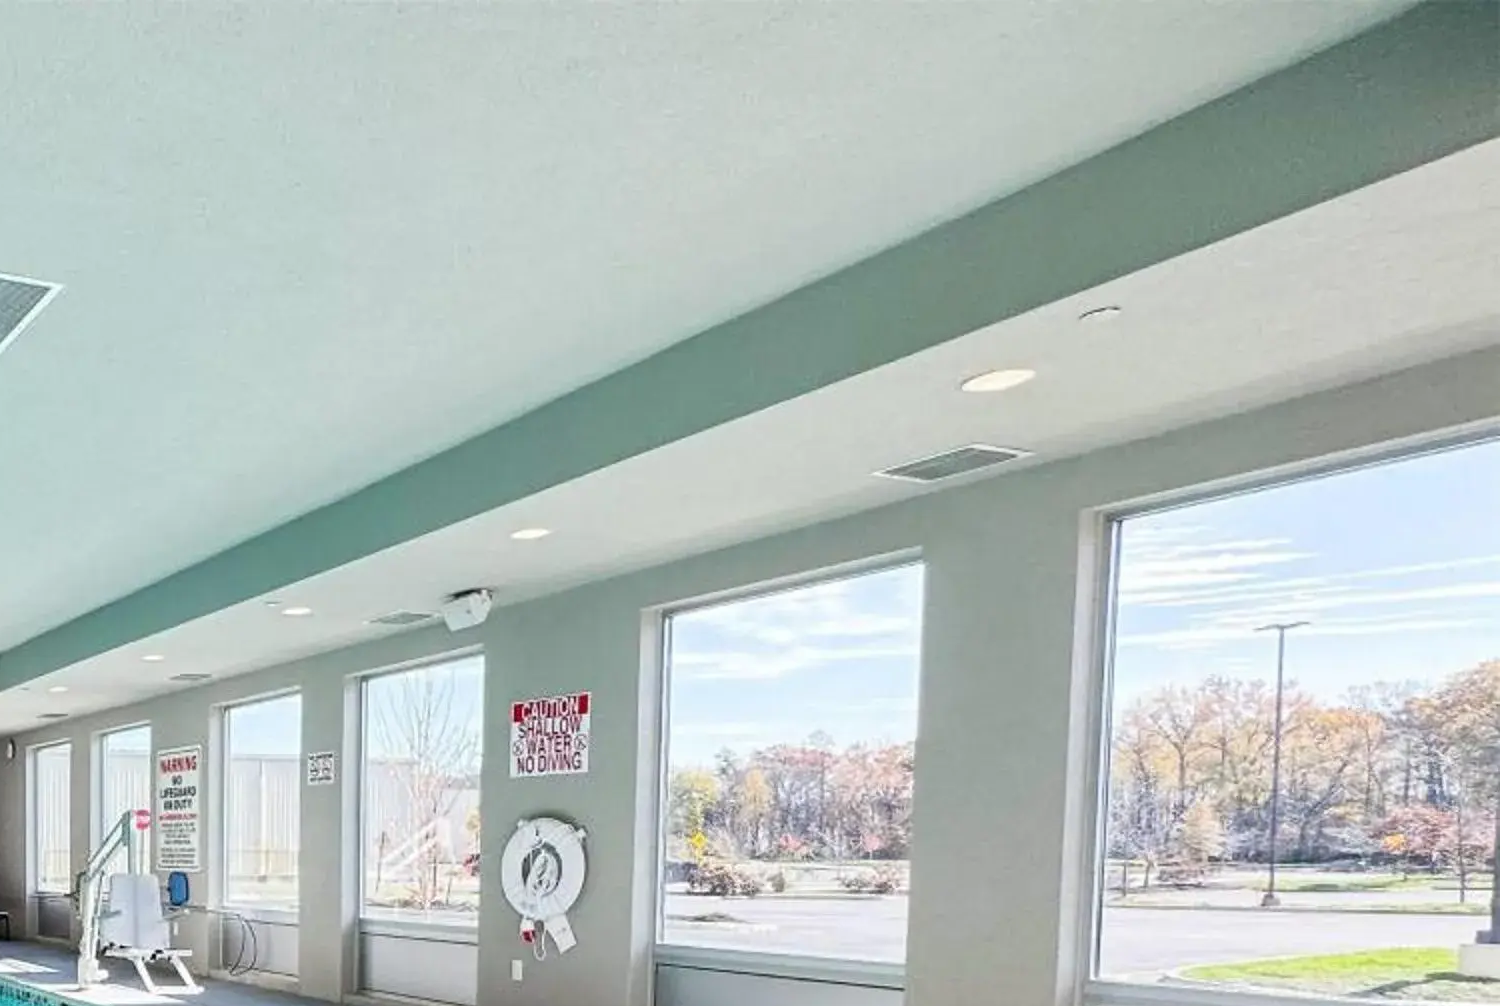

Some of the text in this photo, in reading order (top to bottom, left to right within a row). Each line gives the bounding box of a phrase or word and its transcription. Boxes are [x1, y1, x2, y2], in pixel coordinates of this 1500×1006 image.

[521, 696, 578, 720] CAUTION
[518, 715, 582, 739] SHALLOW
[526, 735, 572, 755] WATER
[160, 755, 197, 774] WARNING
[517, 751, 582, 774] NO DIVING
[171, 775, 183, 785] NO
[159, 785, 197, 799] LIFEGUARD
[174, 798, 193, 811] DUTY
